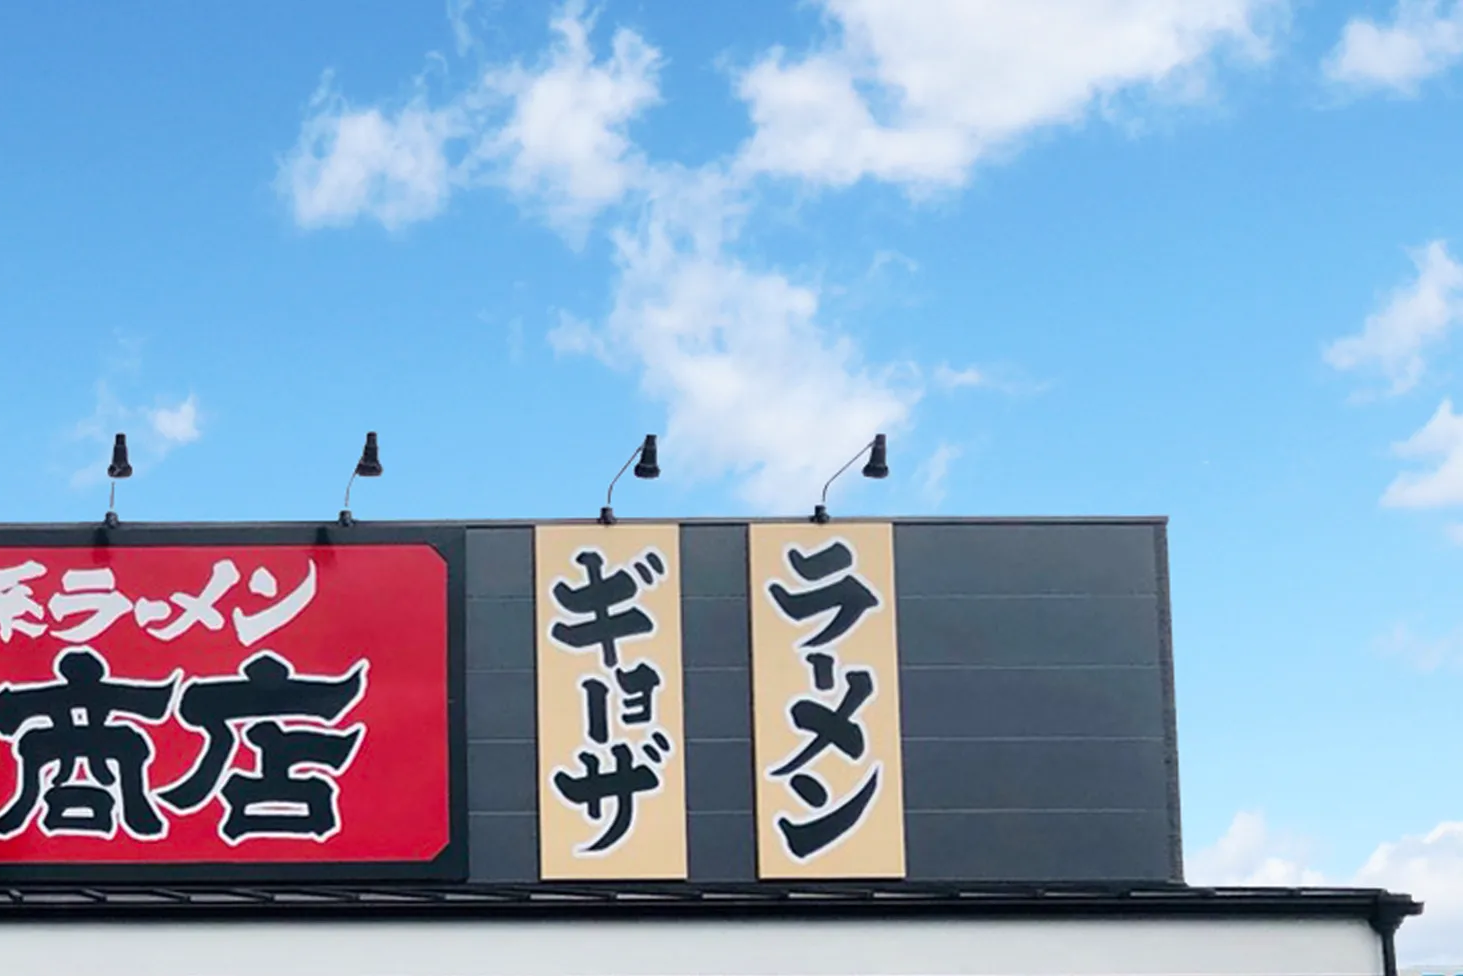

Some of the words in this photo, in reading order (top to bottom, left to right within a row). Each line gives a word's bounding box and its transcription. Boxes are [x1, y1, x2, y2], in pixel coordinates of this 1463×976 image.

[550, 551, 671, 853] ギョーザ
[767, 541, 880, 859] ラーメン
